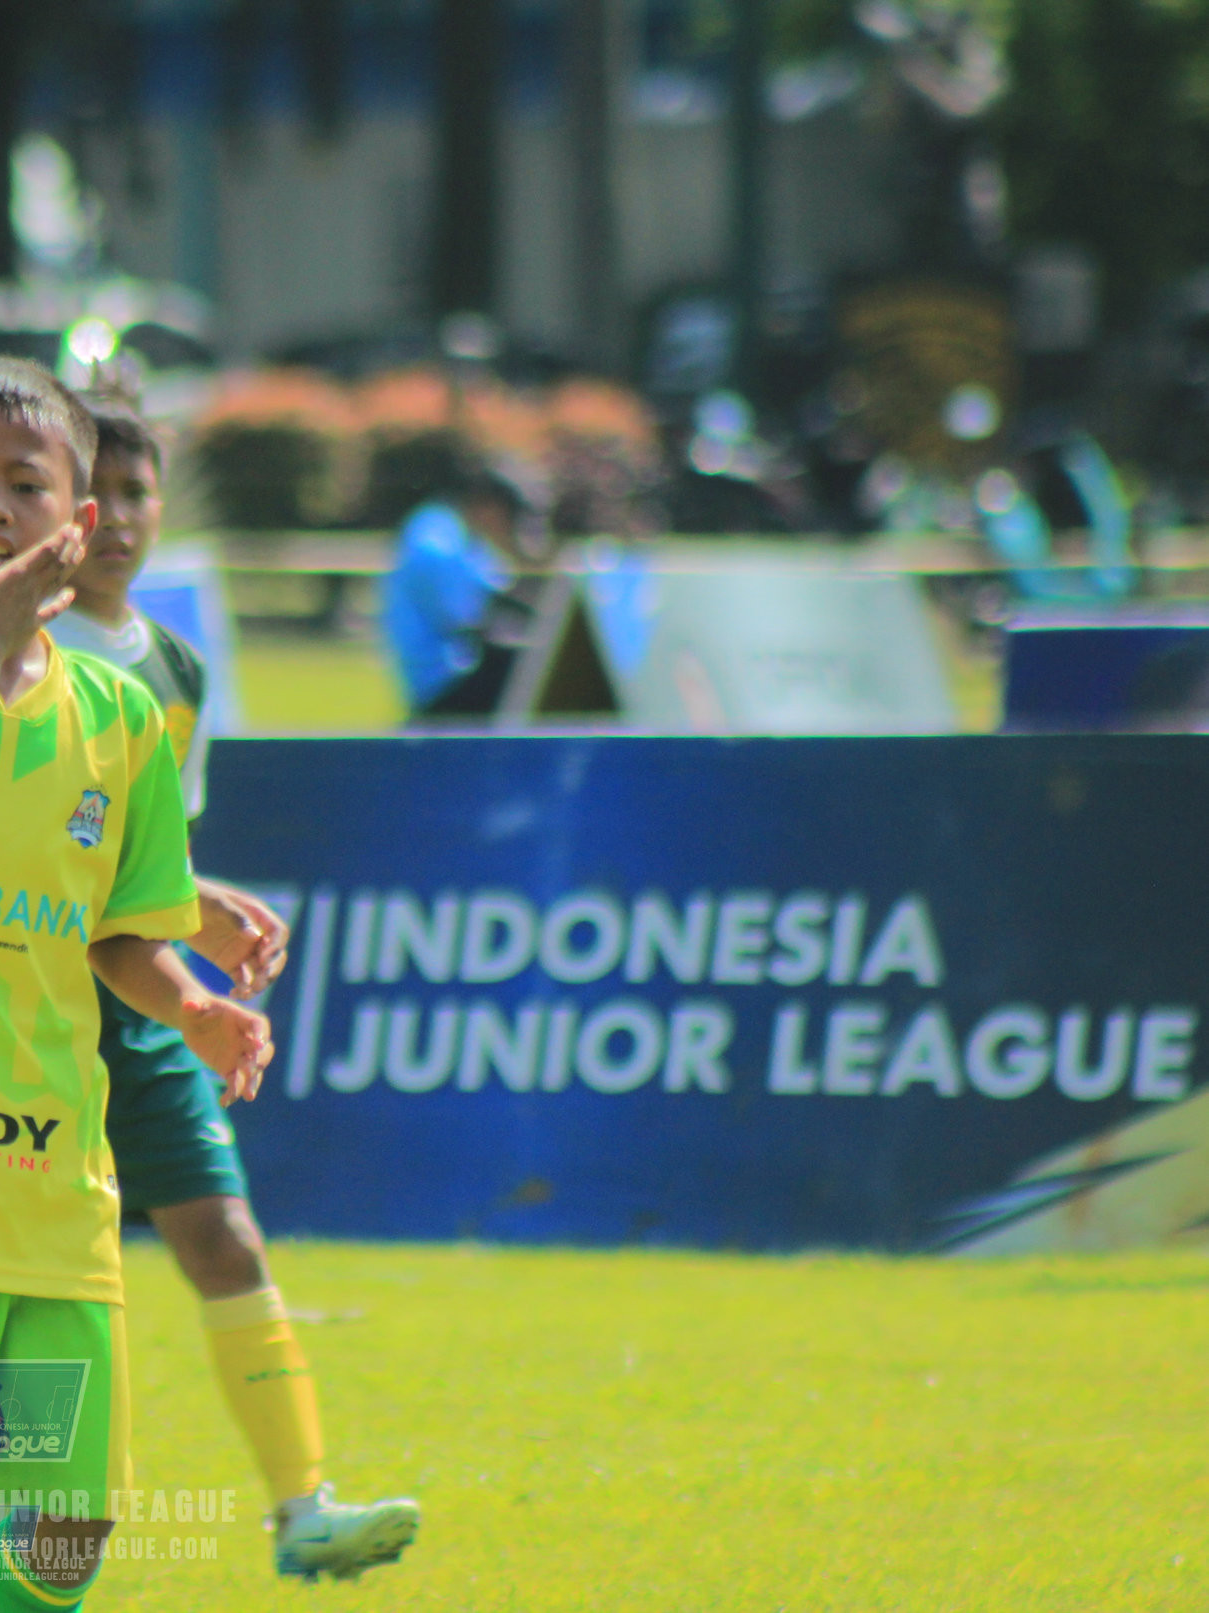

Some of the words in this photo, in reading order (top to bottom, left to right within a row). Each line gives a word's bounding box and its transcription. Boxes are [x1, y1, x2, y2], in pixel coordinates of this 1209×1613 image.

[340, 889, 945, 990] INDONESIA
[322, 998, 733, 1096] JUNIOR
[766, 1002, 1198, 1102] LEAGUE
